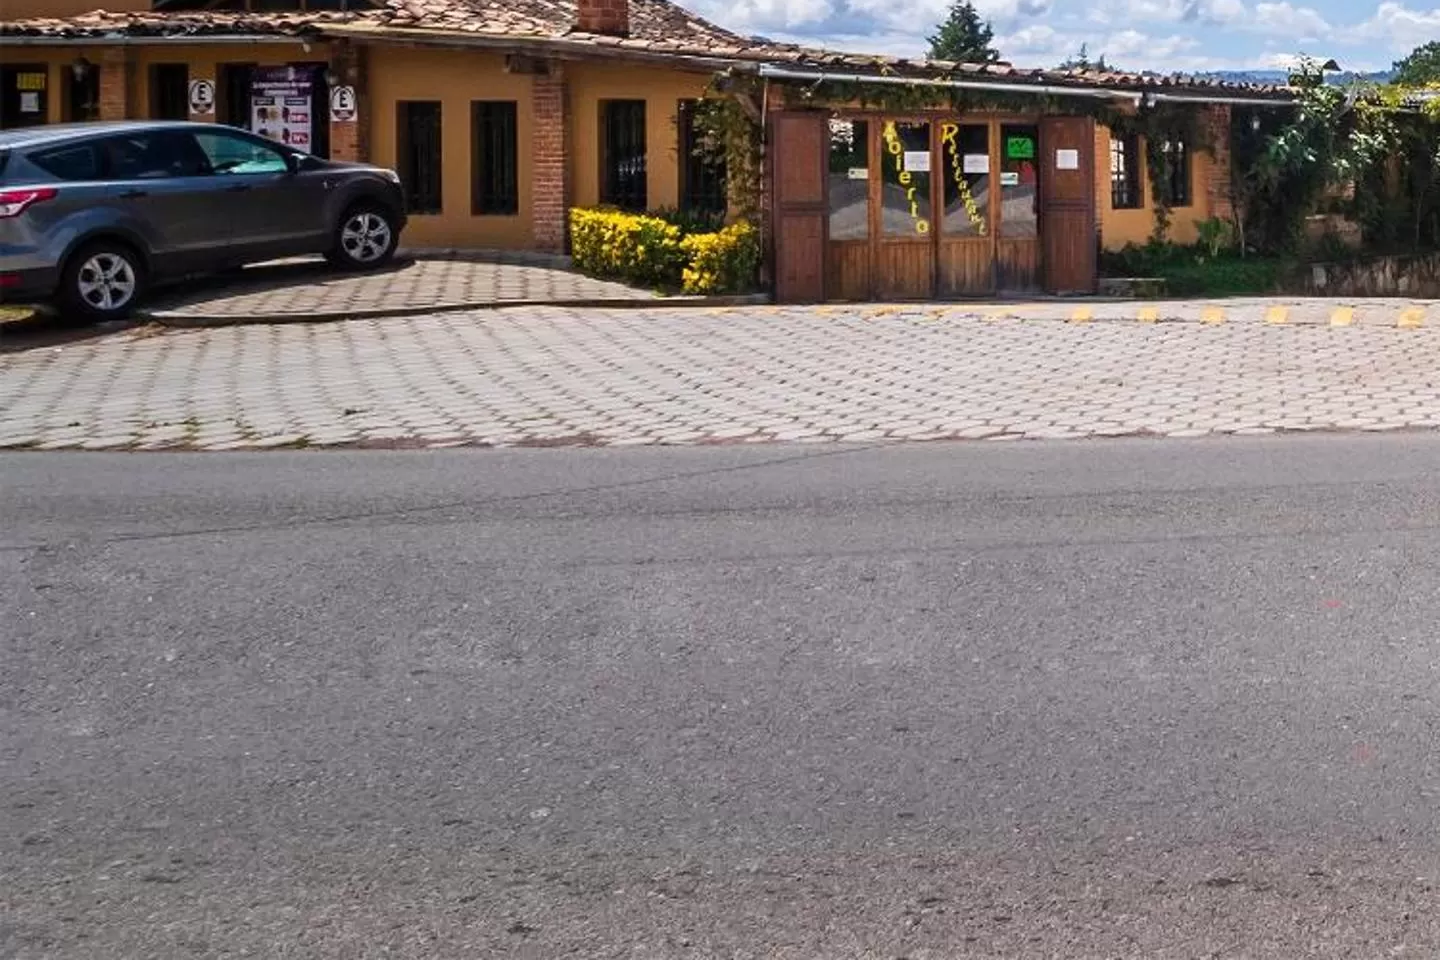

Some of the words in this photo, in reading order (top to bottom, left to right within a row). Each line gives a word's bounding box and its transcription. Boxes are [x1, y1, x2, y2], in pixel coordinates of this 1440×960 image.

[198, 84, 207, 101] E
[339, 90, 349, 108] E
[883, 121, 930, 234] Abierto
